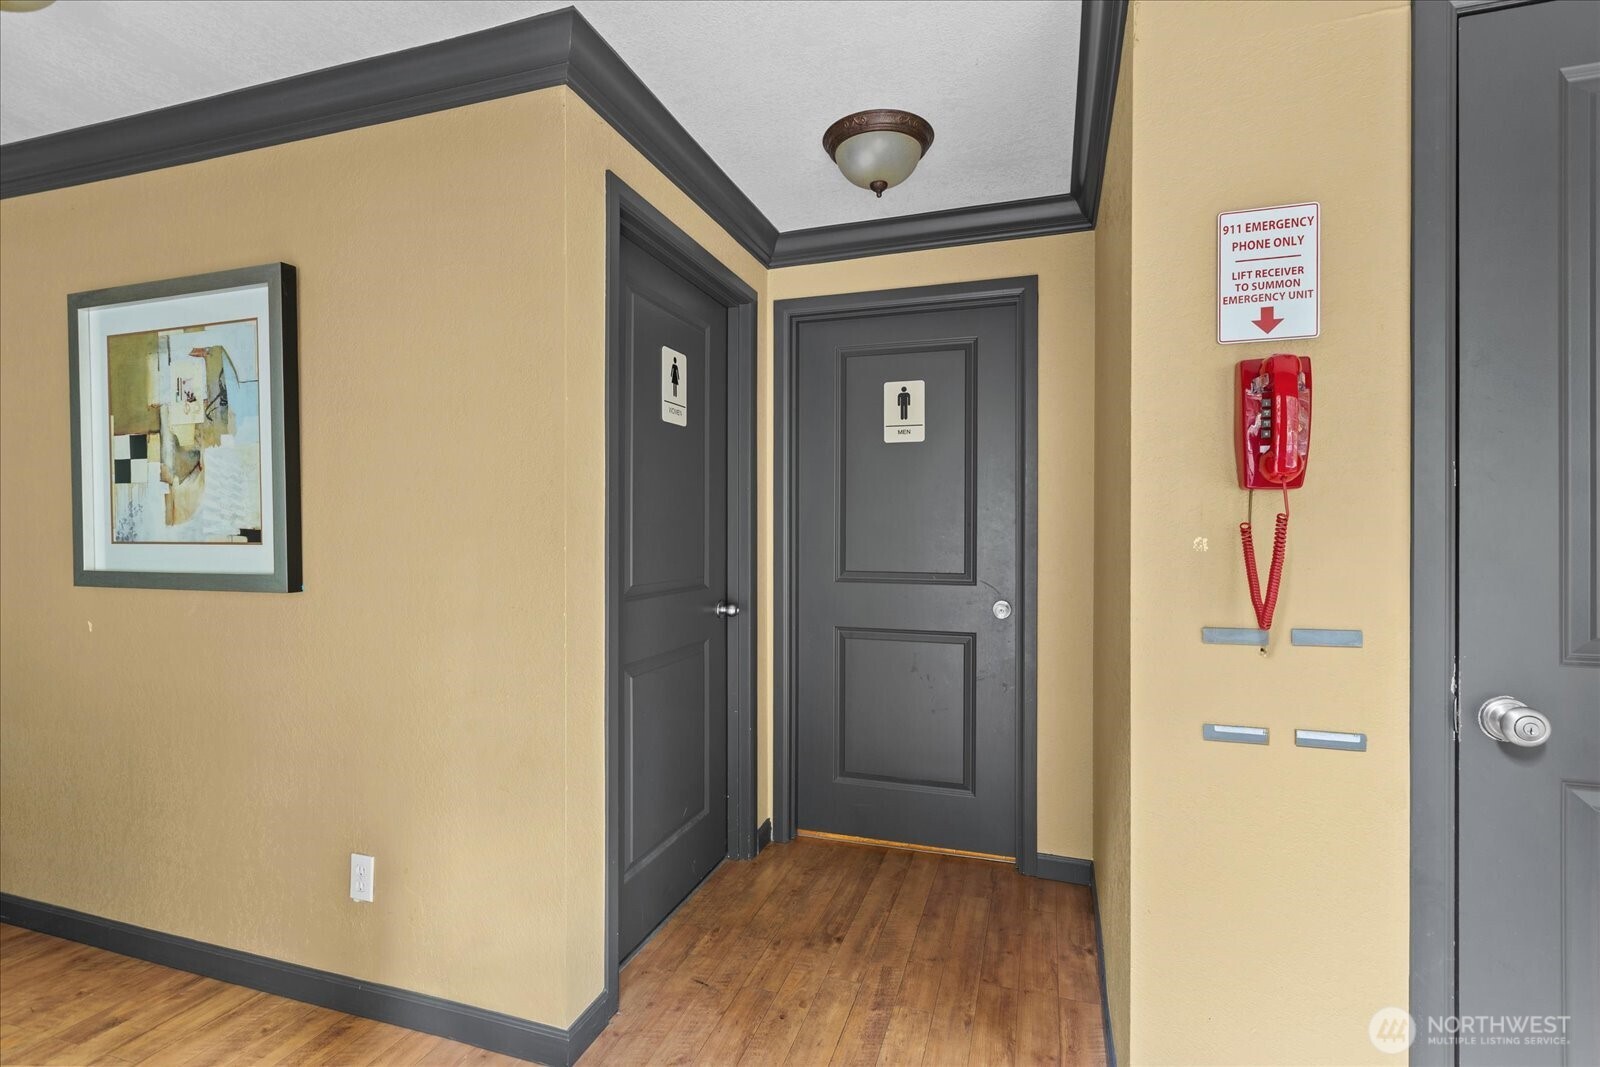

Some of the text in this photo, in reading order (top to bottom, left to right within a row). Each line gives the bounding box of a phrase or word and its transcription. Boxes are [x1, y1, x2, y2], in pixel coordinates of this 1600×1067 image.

[1223, 216, 1314, 235] 911 EMERGENCY
[1232, 235, 1305, 252] PHONE ONLY
[1232, 265, 1305, 281] LIFT RECEIVER
[1234, 278, 1301, 292] TO SUMMON
[1222, 289, 1314, 305] EMERGENCY UNIT
